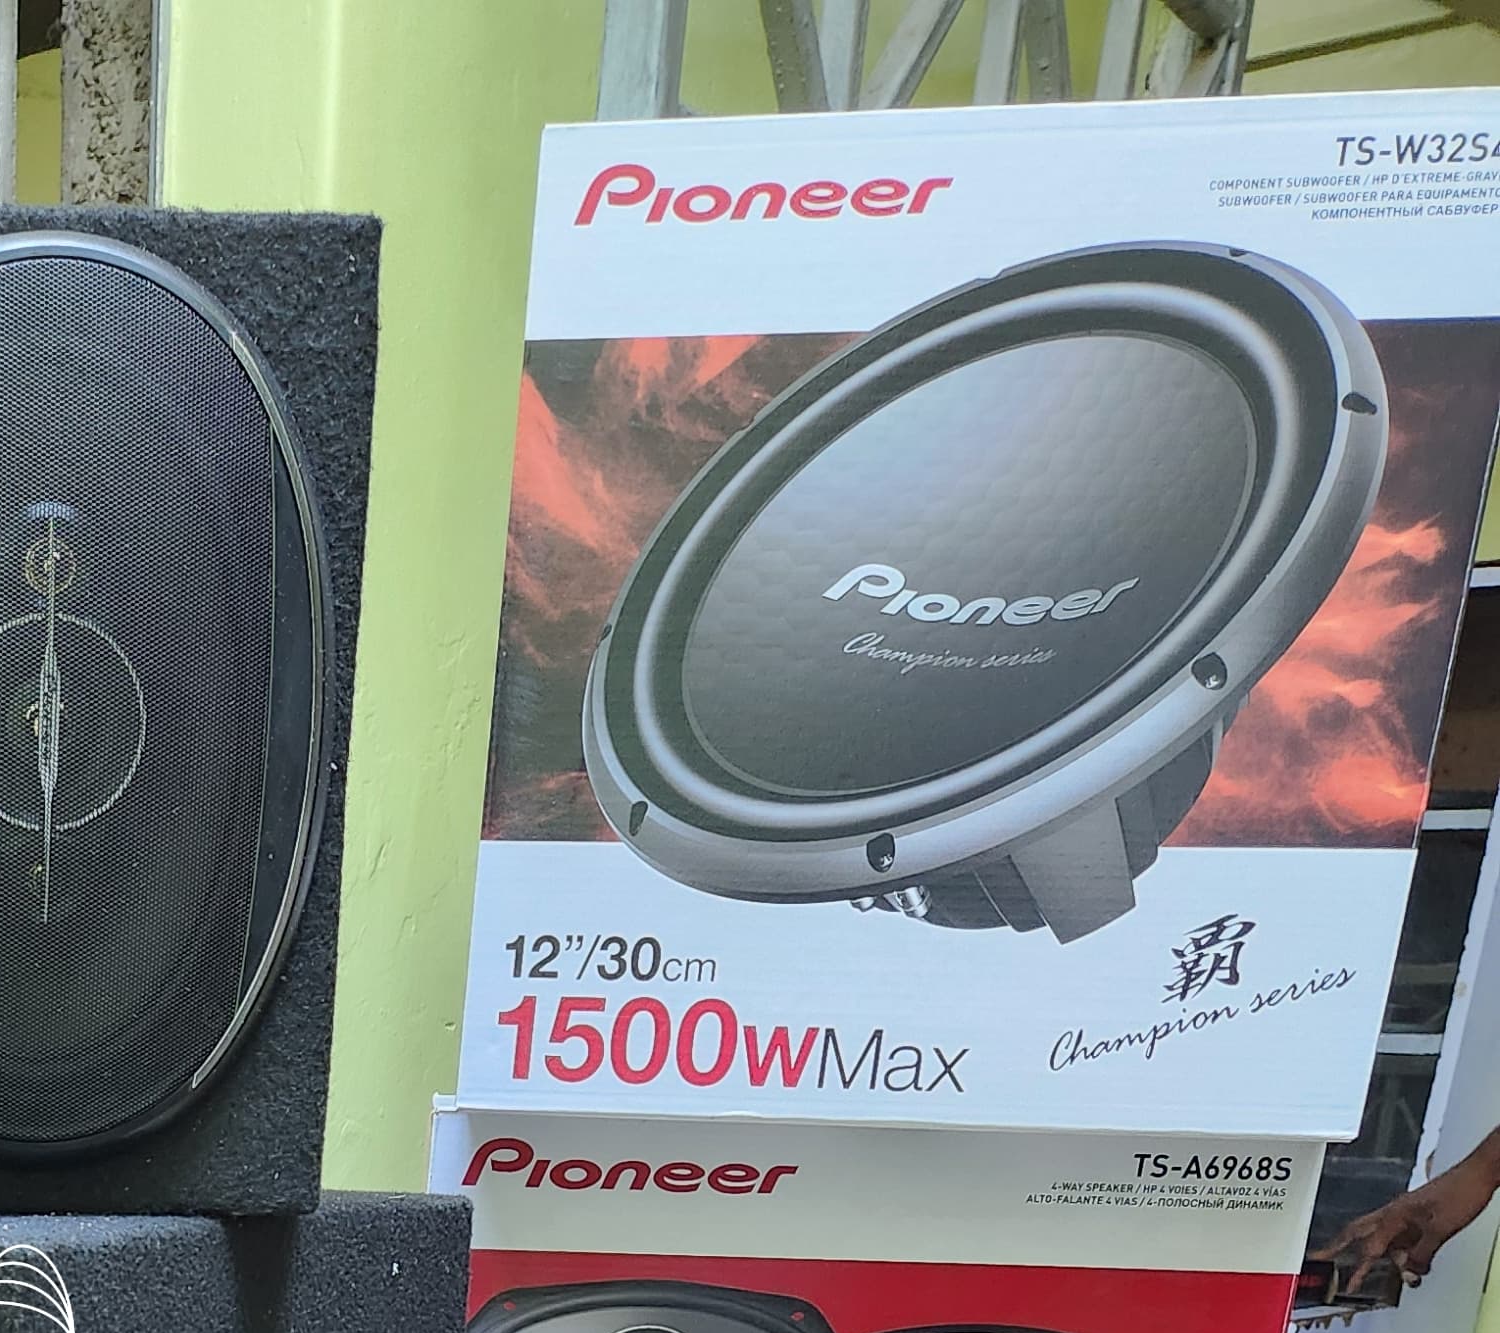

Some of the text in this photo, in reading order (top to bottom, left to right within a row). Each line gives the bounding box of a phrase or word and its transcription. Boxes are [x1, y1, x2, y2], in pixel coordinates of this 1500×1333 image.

[574, 163, 954, 226] Pioneer
[1208, 177, 1284, 191] COMPONENT
[1286, 174, 1361, 188] SUBWOOFER
[1371, 173, 1389, 185] HP
[1390, 171, 1500, 184] D'EXTREME-GRAV
[1218, 194, 1292, 208] SUBWOOFER
[1303, 190, 1377, 205] SUBWOOFER
[1380, 189, 1414, 202] PARA
[1310, 203, 1499, 221] КОМПОНЕНТНЫЙ САБВУФЕР
[821, 562, 1141, 626] Pioneer
[842, 631, 1057, 676] Champion series
[1049, 967, 1357, 1072] Champion series
[461, 1137, 799, 1194] Pioneer
[1133, 1153, 1293, 1182] TS-A6968S
[1026, 1194, 1104, 1205] ALTO-FALANTE
[1113, 1196, 1138, 1206] VIAS
[1146, 1197, 1224, 1209] 4-ПОЛОСНЫЙ
[1225, 1199, 1284, 1211] ДИНАМИК
[1051, 1182, 1084, 1192] 4-WAY
[1085, 1183, 1134, 1193] SPEAKER
[1142, 1184, 1158, 1194] HP
[1167, 1185, 1198, 1195] VOIES
[1206, 1186, 1252, 1196] ALTAVOZ
